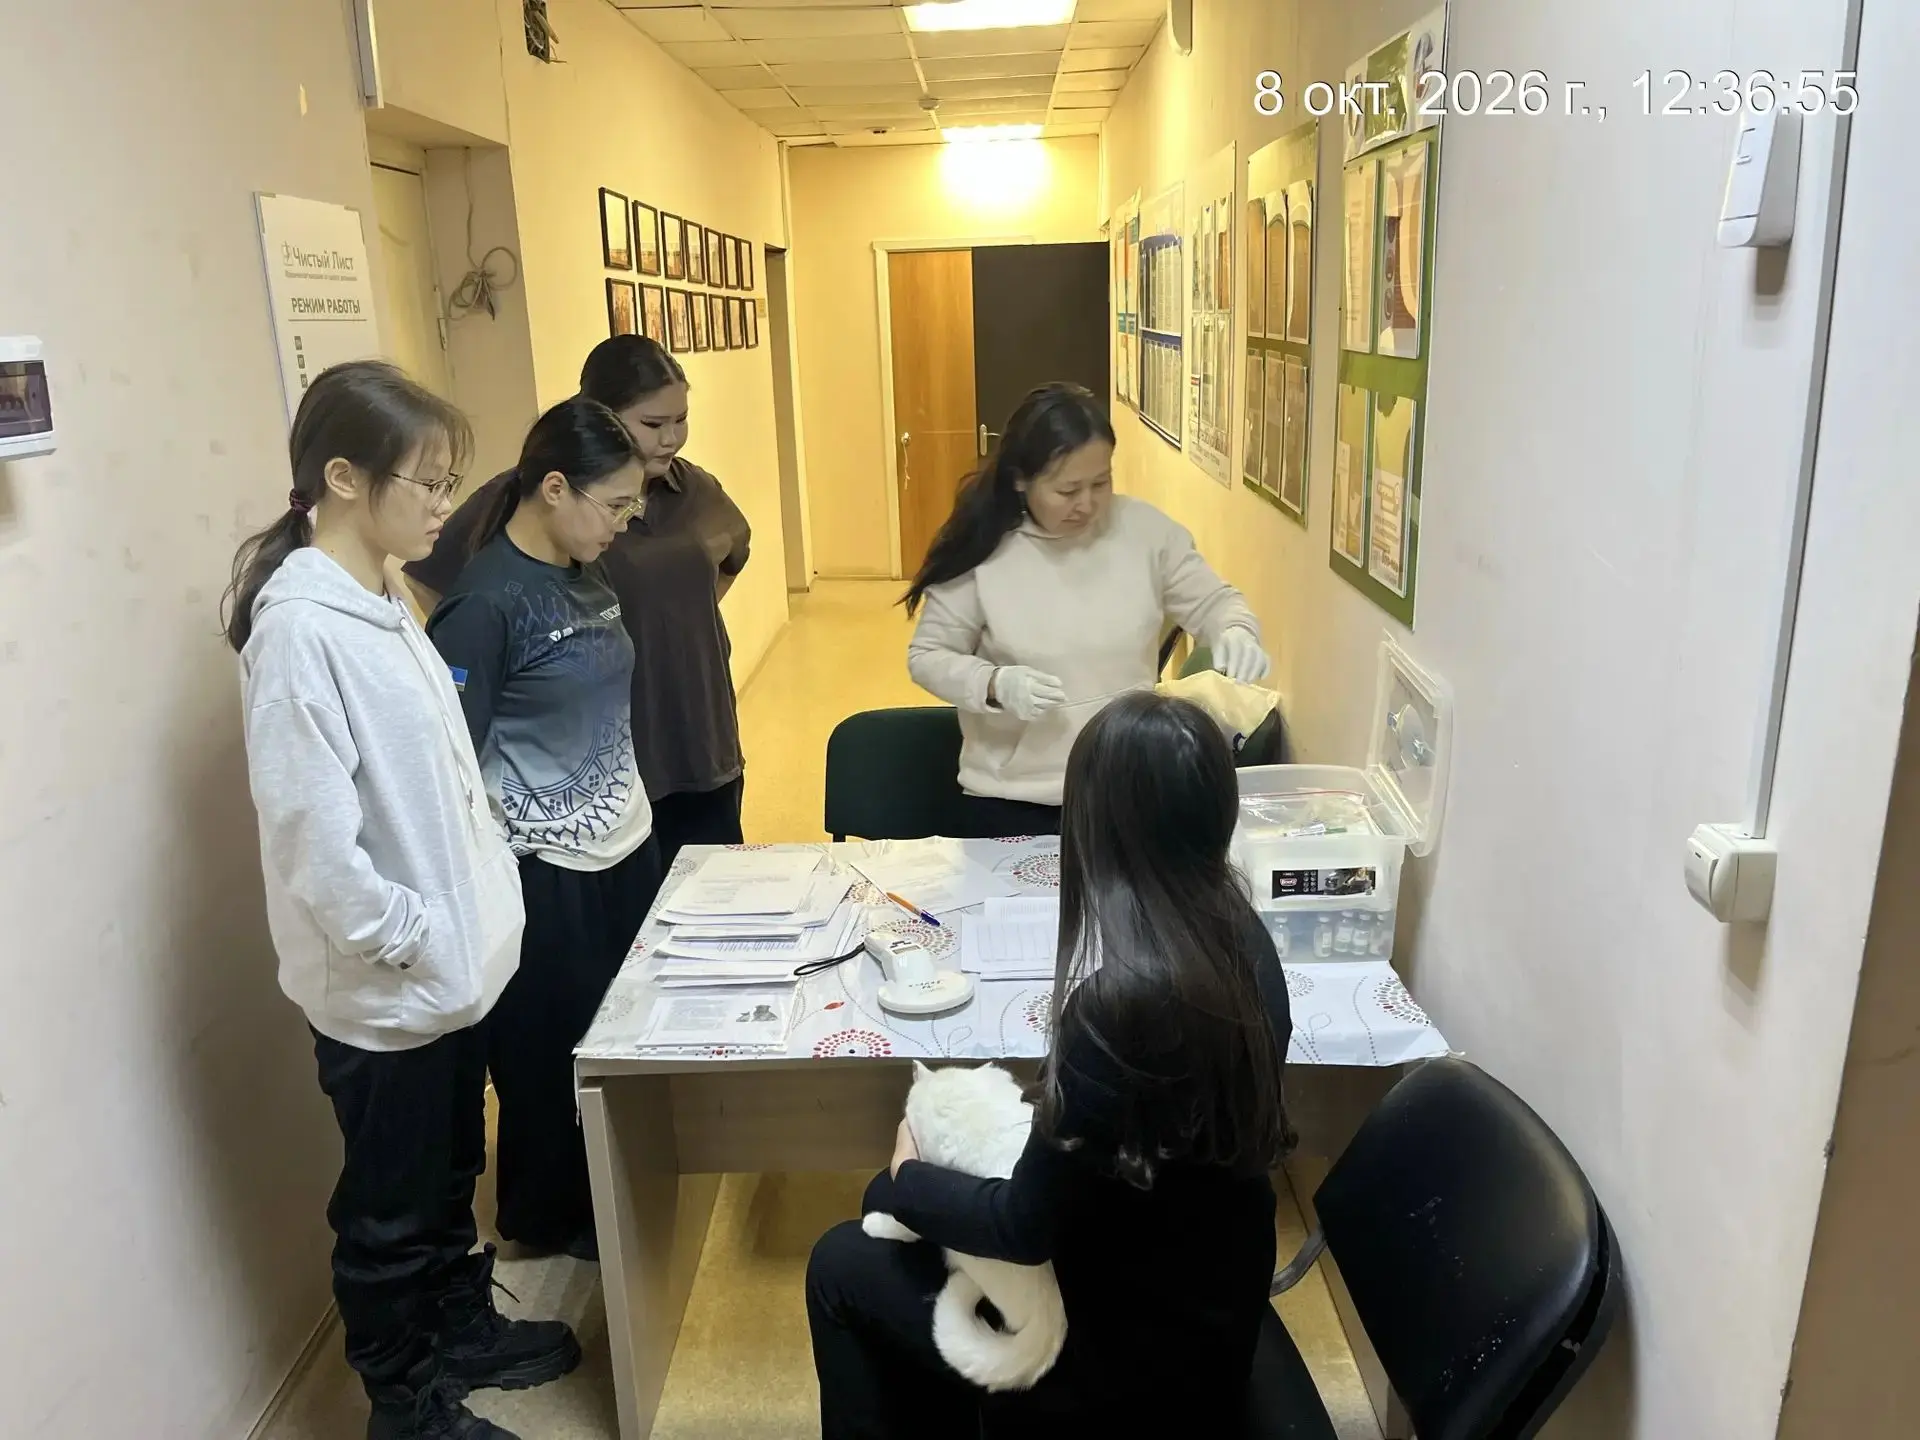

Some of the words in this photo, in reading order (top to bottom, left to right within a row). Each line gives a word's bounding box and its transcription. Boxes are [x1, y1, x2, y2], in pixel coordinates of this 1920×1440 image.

[292, 247, 330, 269] Чистый
[332, 250, 354, 270] Лист
[291, 297, 326, 314] РЕЖИМ
[327, 298, 361, 315] РАБОТЫ
